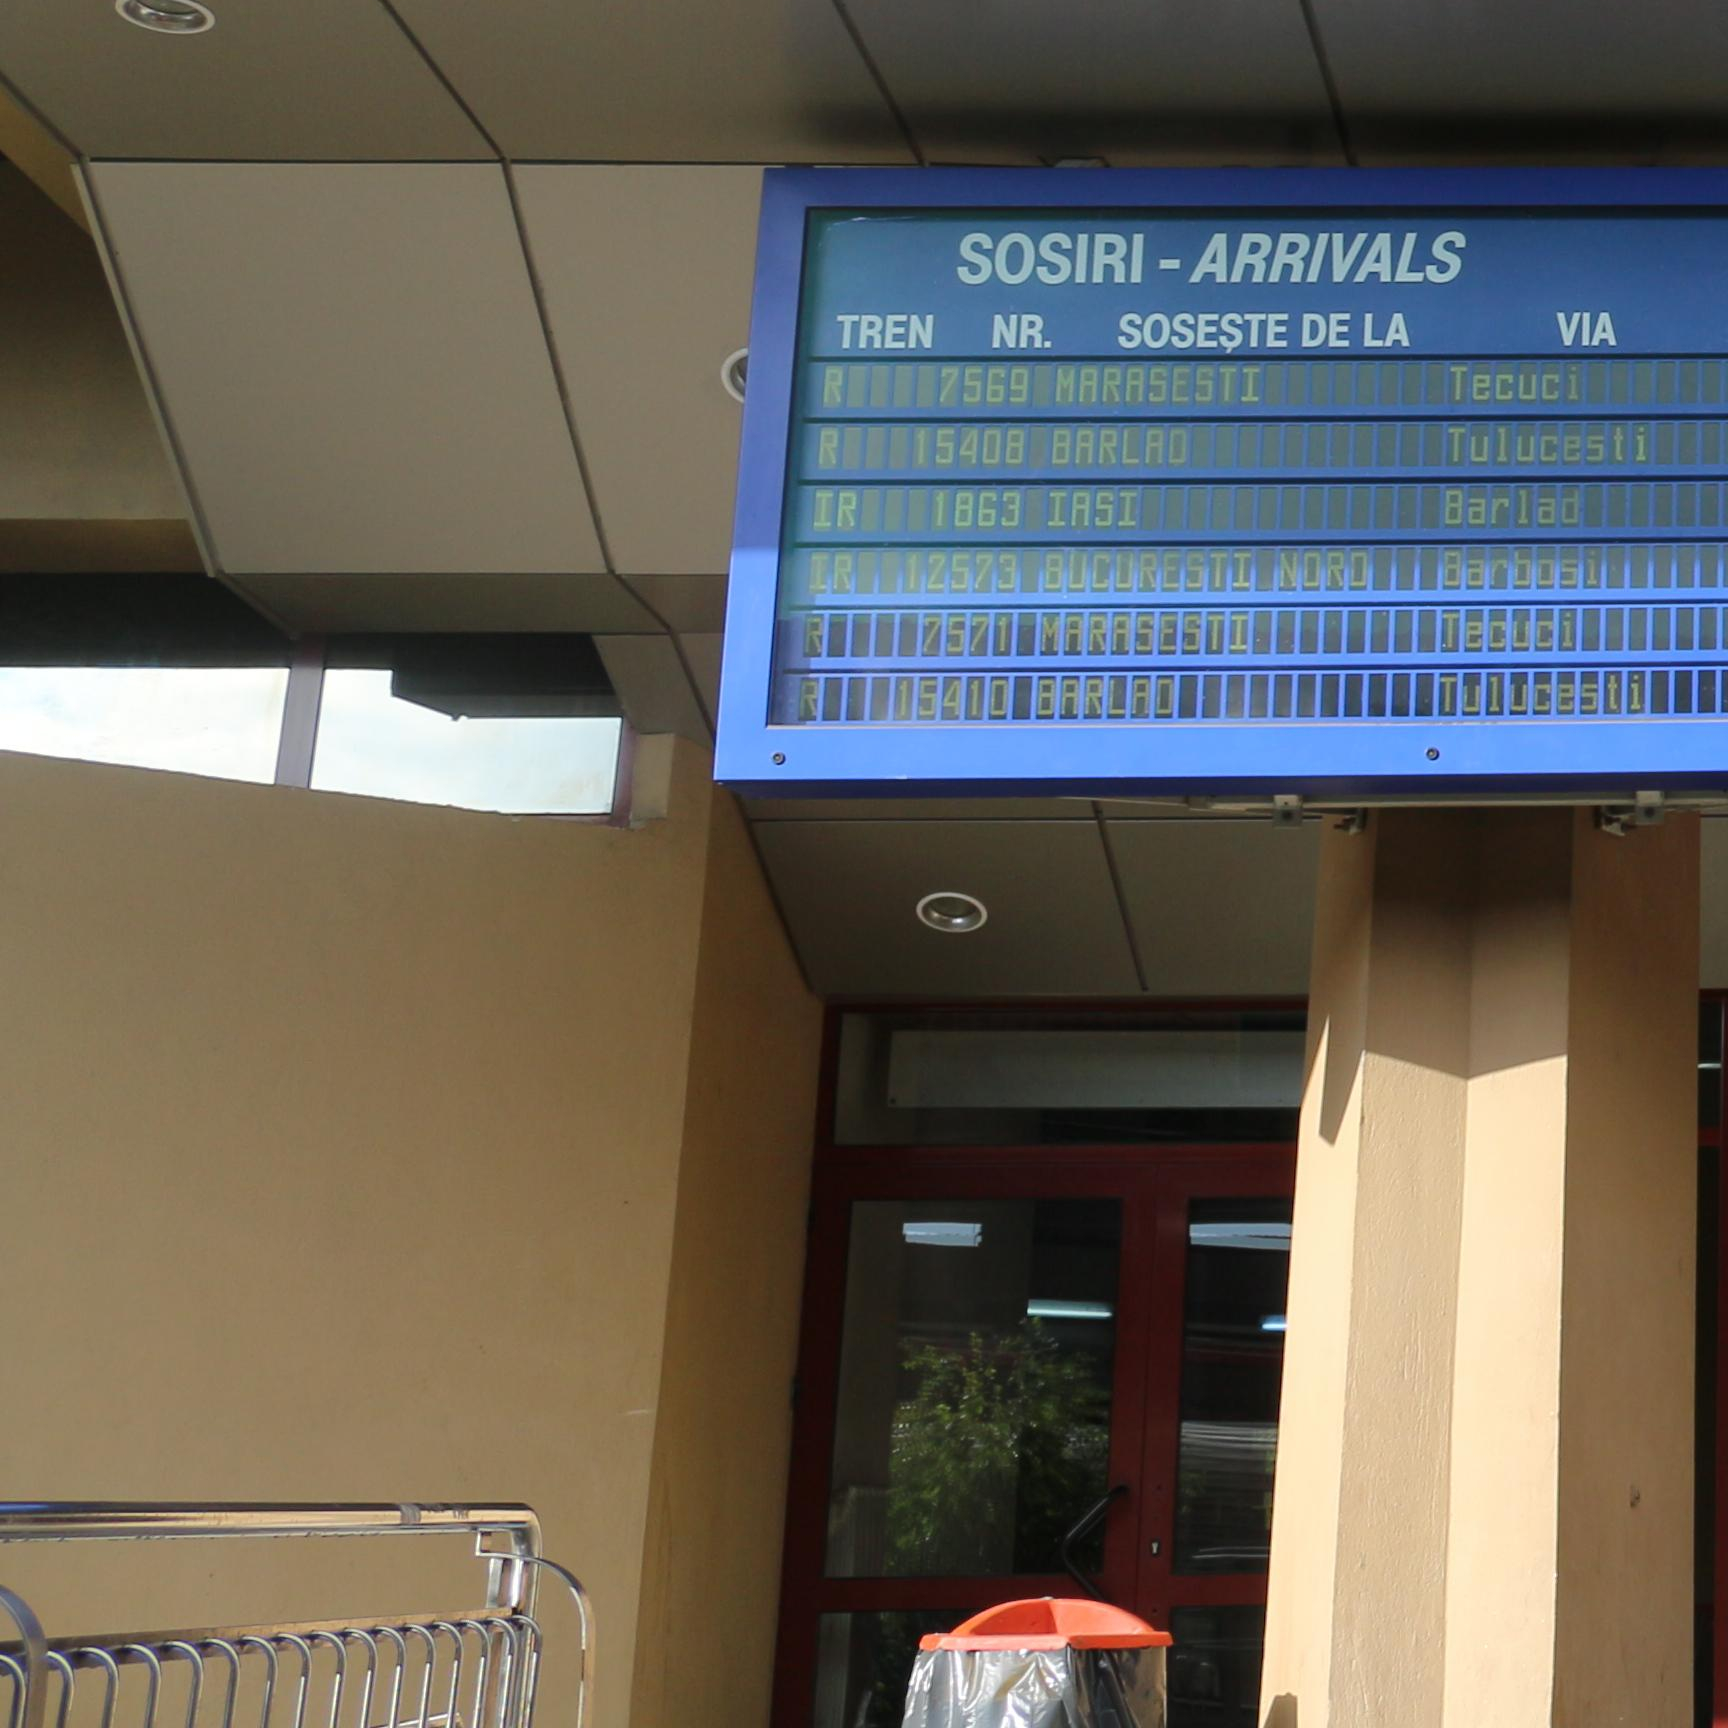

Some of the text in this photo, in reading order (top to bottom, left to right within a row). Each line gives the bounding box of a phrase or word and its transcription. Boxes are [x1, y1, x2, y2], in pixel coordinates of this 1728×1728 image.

[957, 231, 1466, 284] SOSIRI - ARRIVALS
[837, 314, 933, 349] TREN
[992, 314, 1051, 349] NR.
[1118, 313, 1288, 353] SOSEȘTE
[1302, 313, 1350, 347] DE
[1363, 313, 1410, 347] LA
[1557, 312, 1617, 346] VIA
[823, 368, 843, 403] R
[940, 367, 1030, 403] 7569
[1055, 367, 1260, 403] MARASESTI
[1450, 366, 1579, 400] Tecuci
[819, 428, 840, 465] R
[917, 429, 1025, 465] 15408
[1448, 427, 1647, 462] Tulucesti
[814, 491, 857, 527] IR
[936, 491, 1020, 527] 1863
[1048, 491, 1137, 527] IASI
[1445, 489, 1580, 525] Barlad
[810, 553, 852, 590] IR
[906, 552, 1018, 590] 12573
[1044, 552, 1252, 589] BUCURESTI
[1444, 551, 1598, 587] Barbosi
[806, 617, 823, 653] R
[923, 616, 1008, 652] 7571
[1042, 615, 1248, 652] MARASESTI
[1442, 612, 1574, 648] Tecuci
[802, 679, 818, 715] R
[898, 679, 1008, 716] 15410
[1440, 674, 1642, 712] Tulucesti
